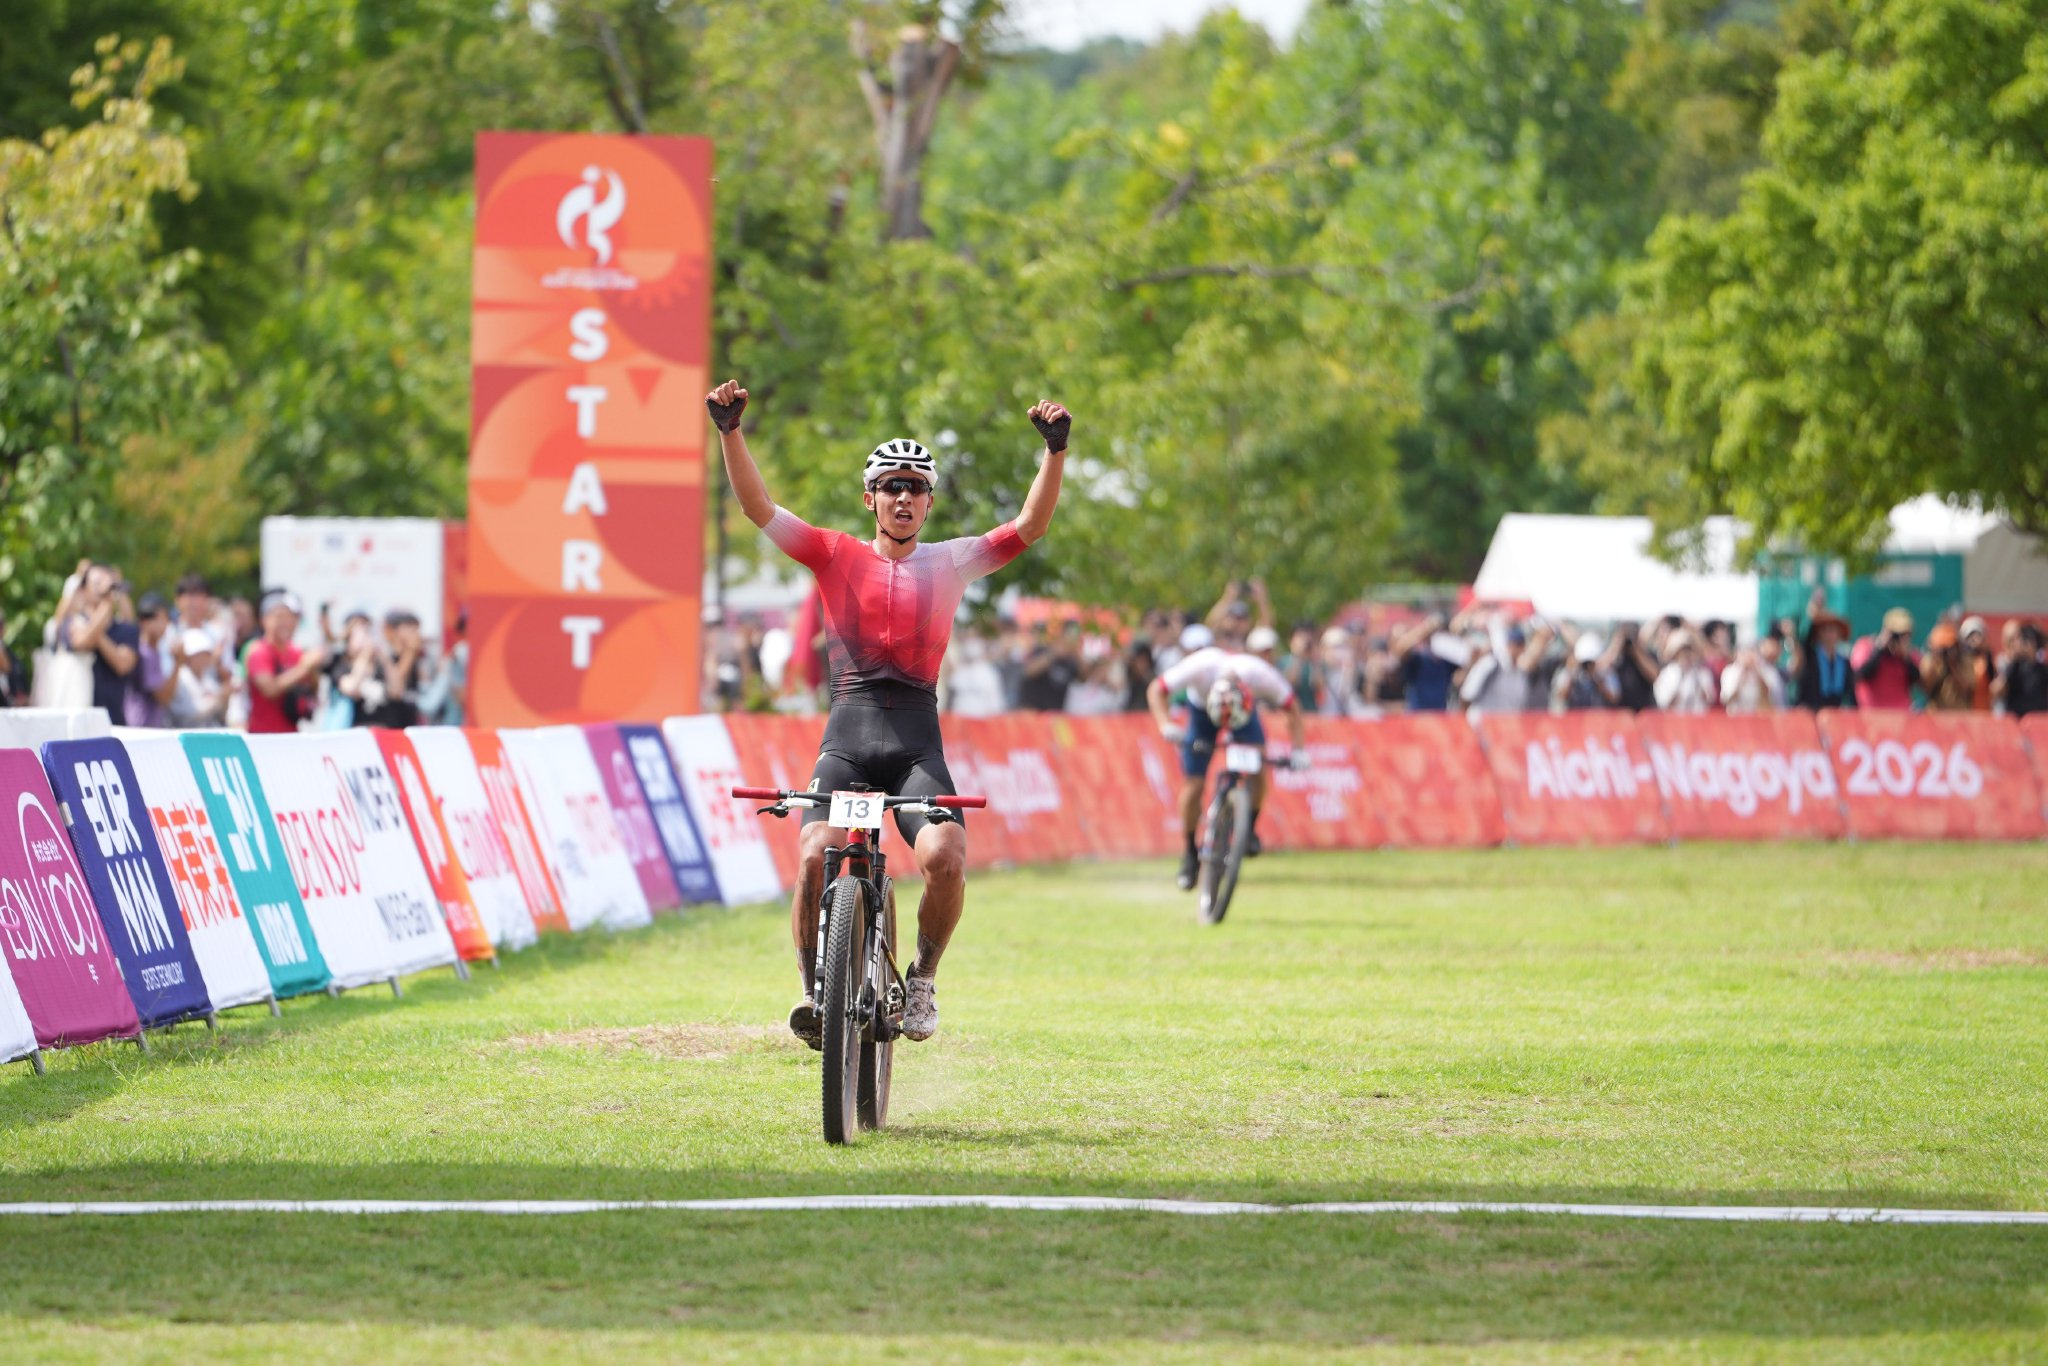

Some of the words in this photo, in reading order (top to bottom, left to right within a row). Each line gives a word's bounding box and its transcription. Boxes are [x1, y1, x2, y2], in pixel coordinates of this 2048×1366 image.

[561, 307, 609, 669] START
[201, 757, 272, 872] ニトリ
[844, 799, 870, 819] 13
[1526, 734, 1837, 816] Aichi-Nagoya
[1839, 737, 1984, 799] 2026
[276, 808, 361, 899] DENSO
